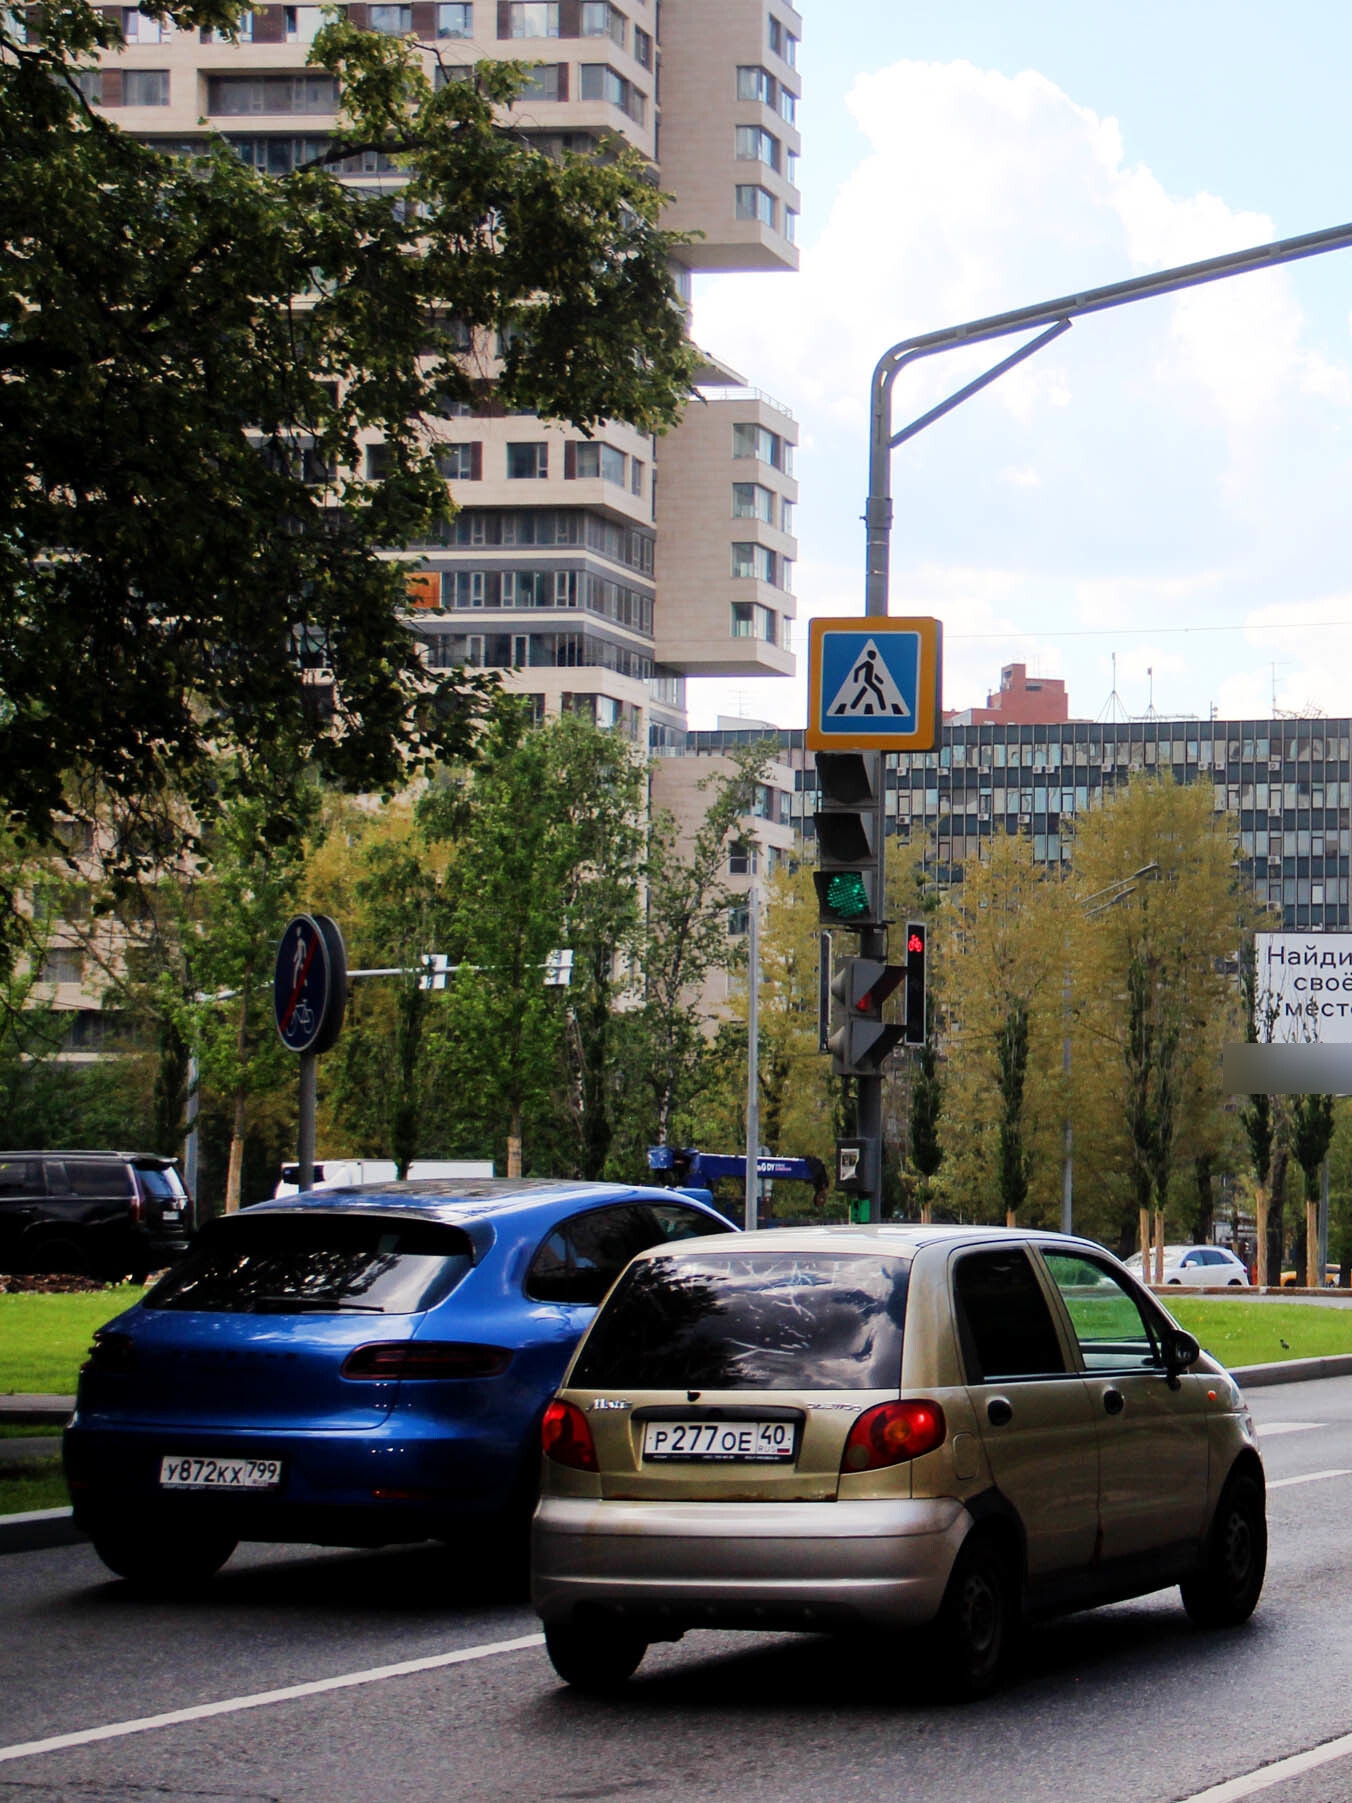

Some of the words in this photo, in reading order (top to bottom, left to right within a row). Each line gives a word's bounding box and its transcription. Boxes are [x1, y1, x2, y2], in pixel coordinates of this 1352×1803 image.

[654, 1426, 752, 1451] Р277ОЕ
[760, 1425, 785, 1445] 40
[168, 1460, 243, 1484] У872КХ
[247, 1461, 278, 1479] 799
